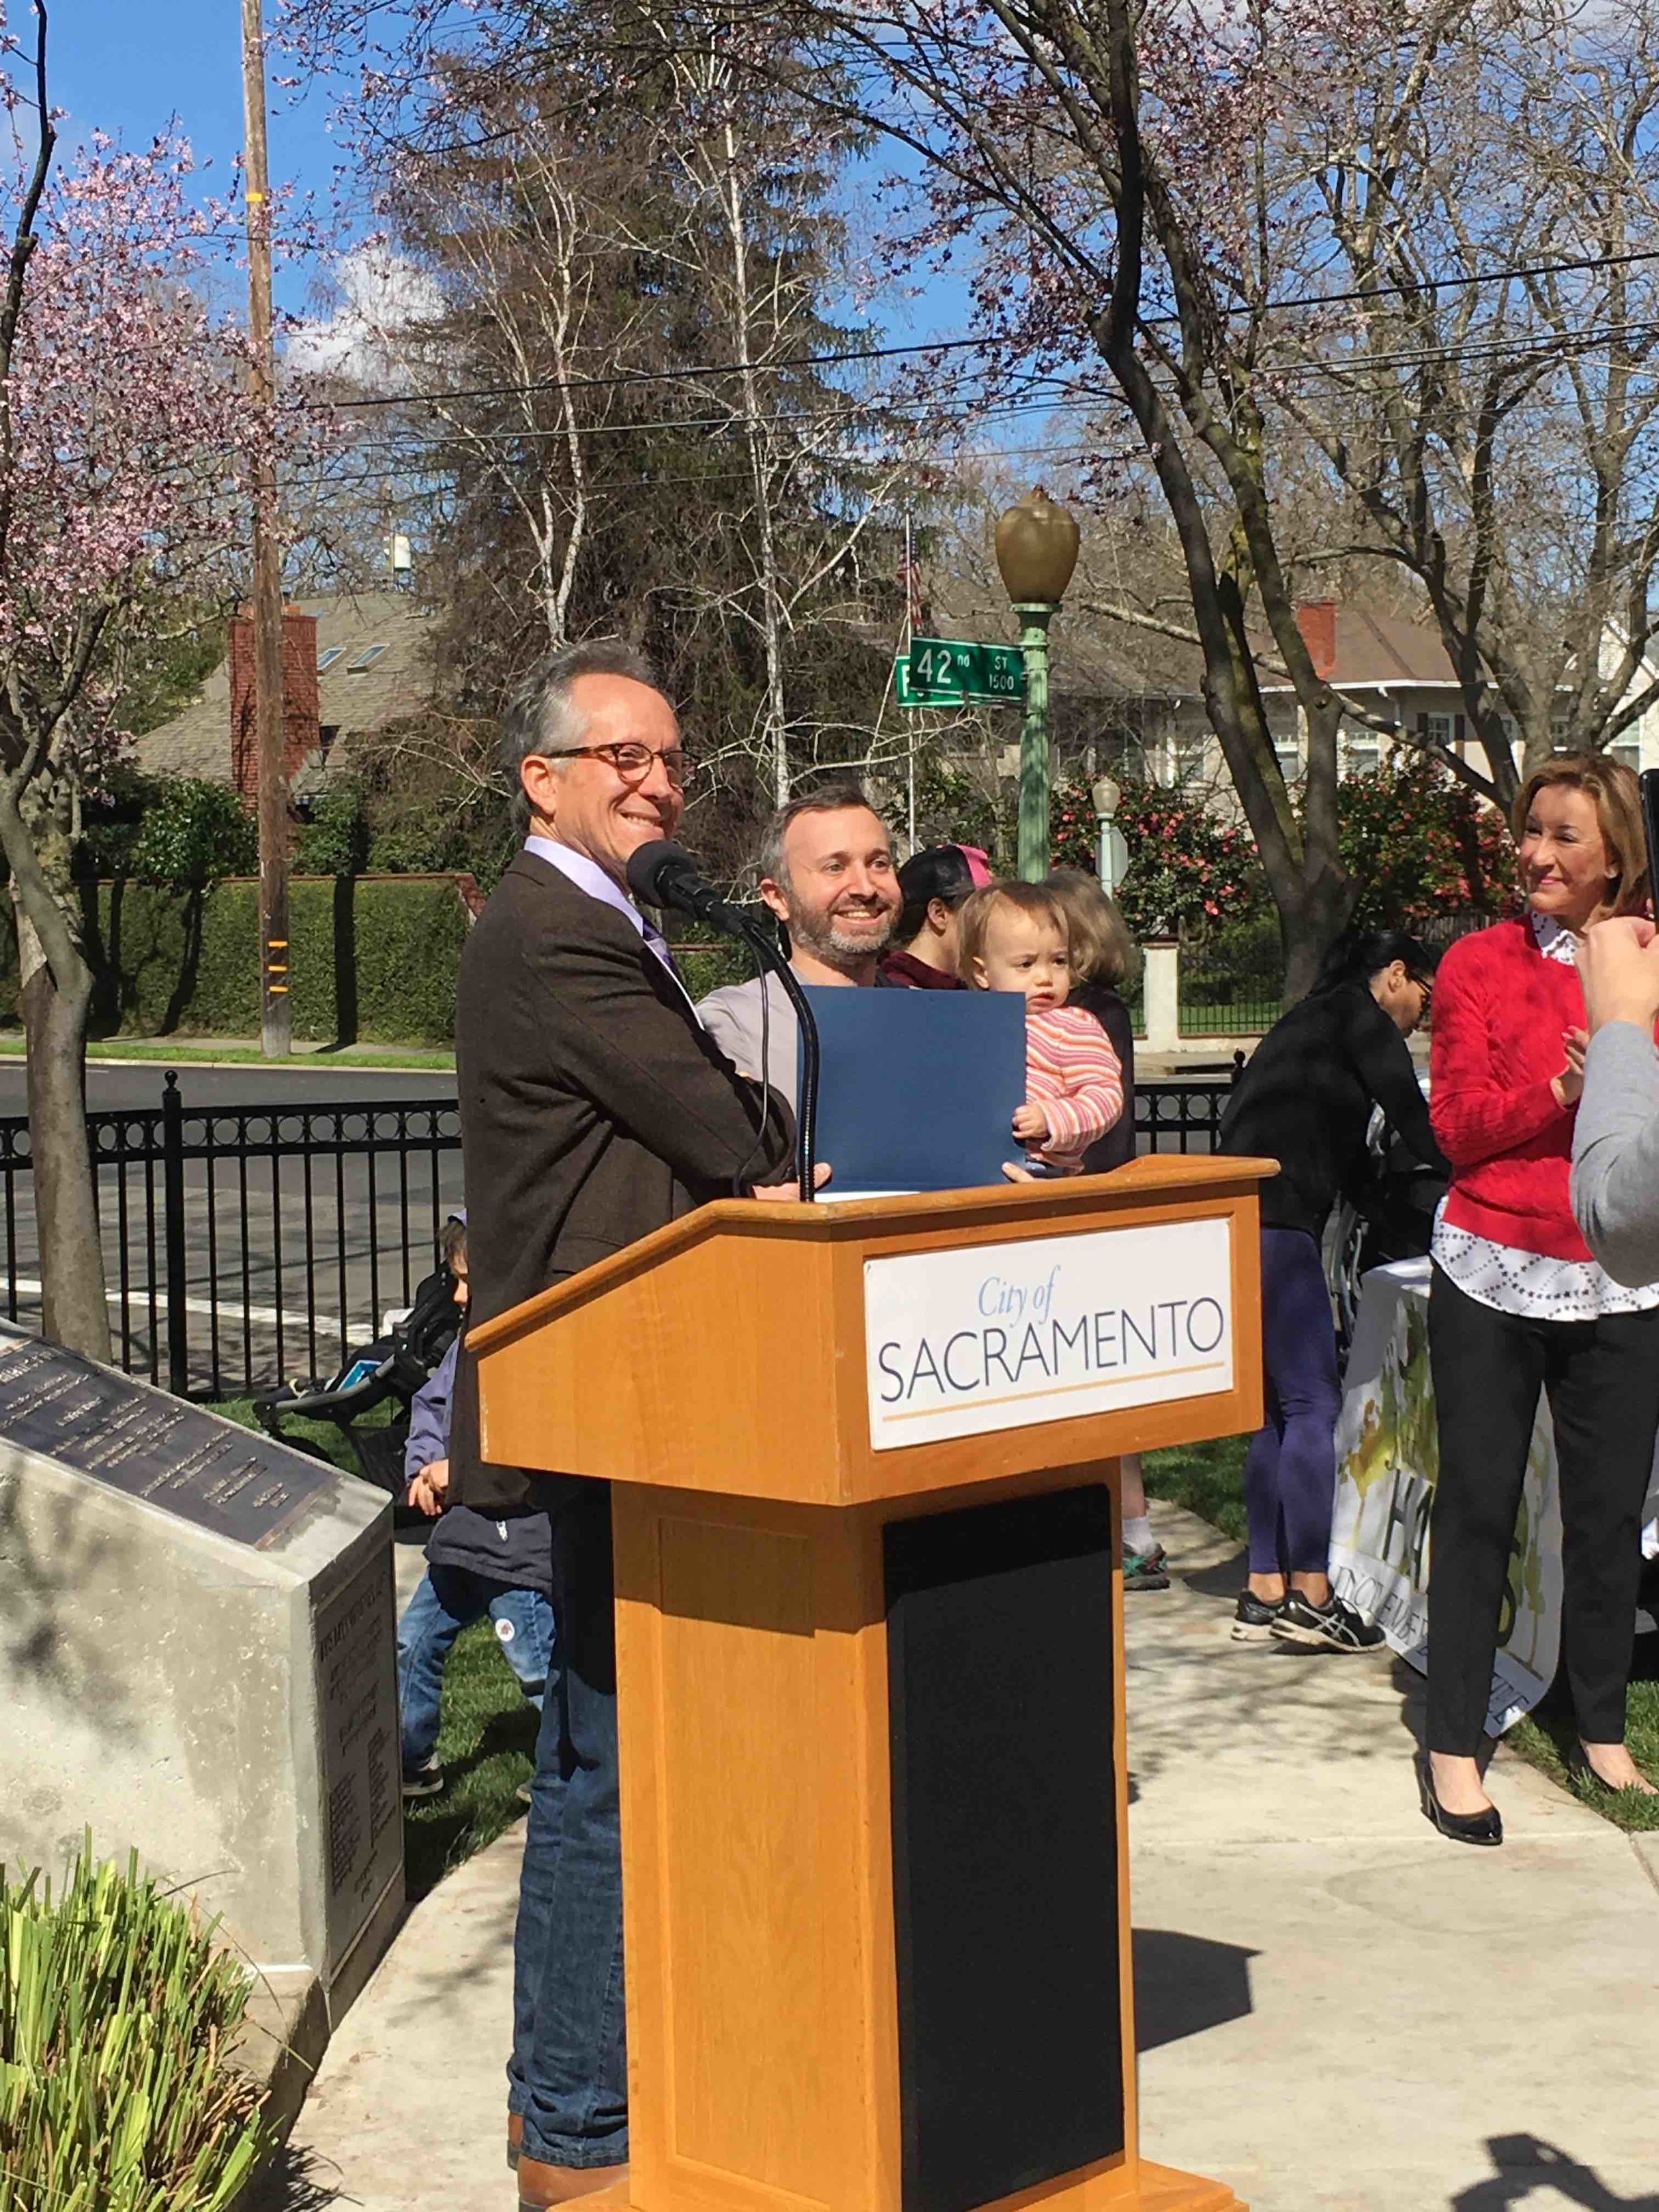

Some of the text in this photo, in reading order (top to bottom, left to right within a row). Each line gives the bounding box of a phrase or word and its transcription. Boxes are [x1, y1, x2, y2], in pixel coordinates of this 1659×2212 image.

[989, 674, 1014, 690] 1500
[995, 655, 1007, 670] ST
[978, 1264, 1061, 1327] City of
[878, 1297, 1225, 1402] SACRAMENTO
